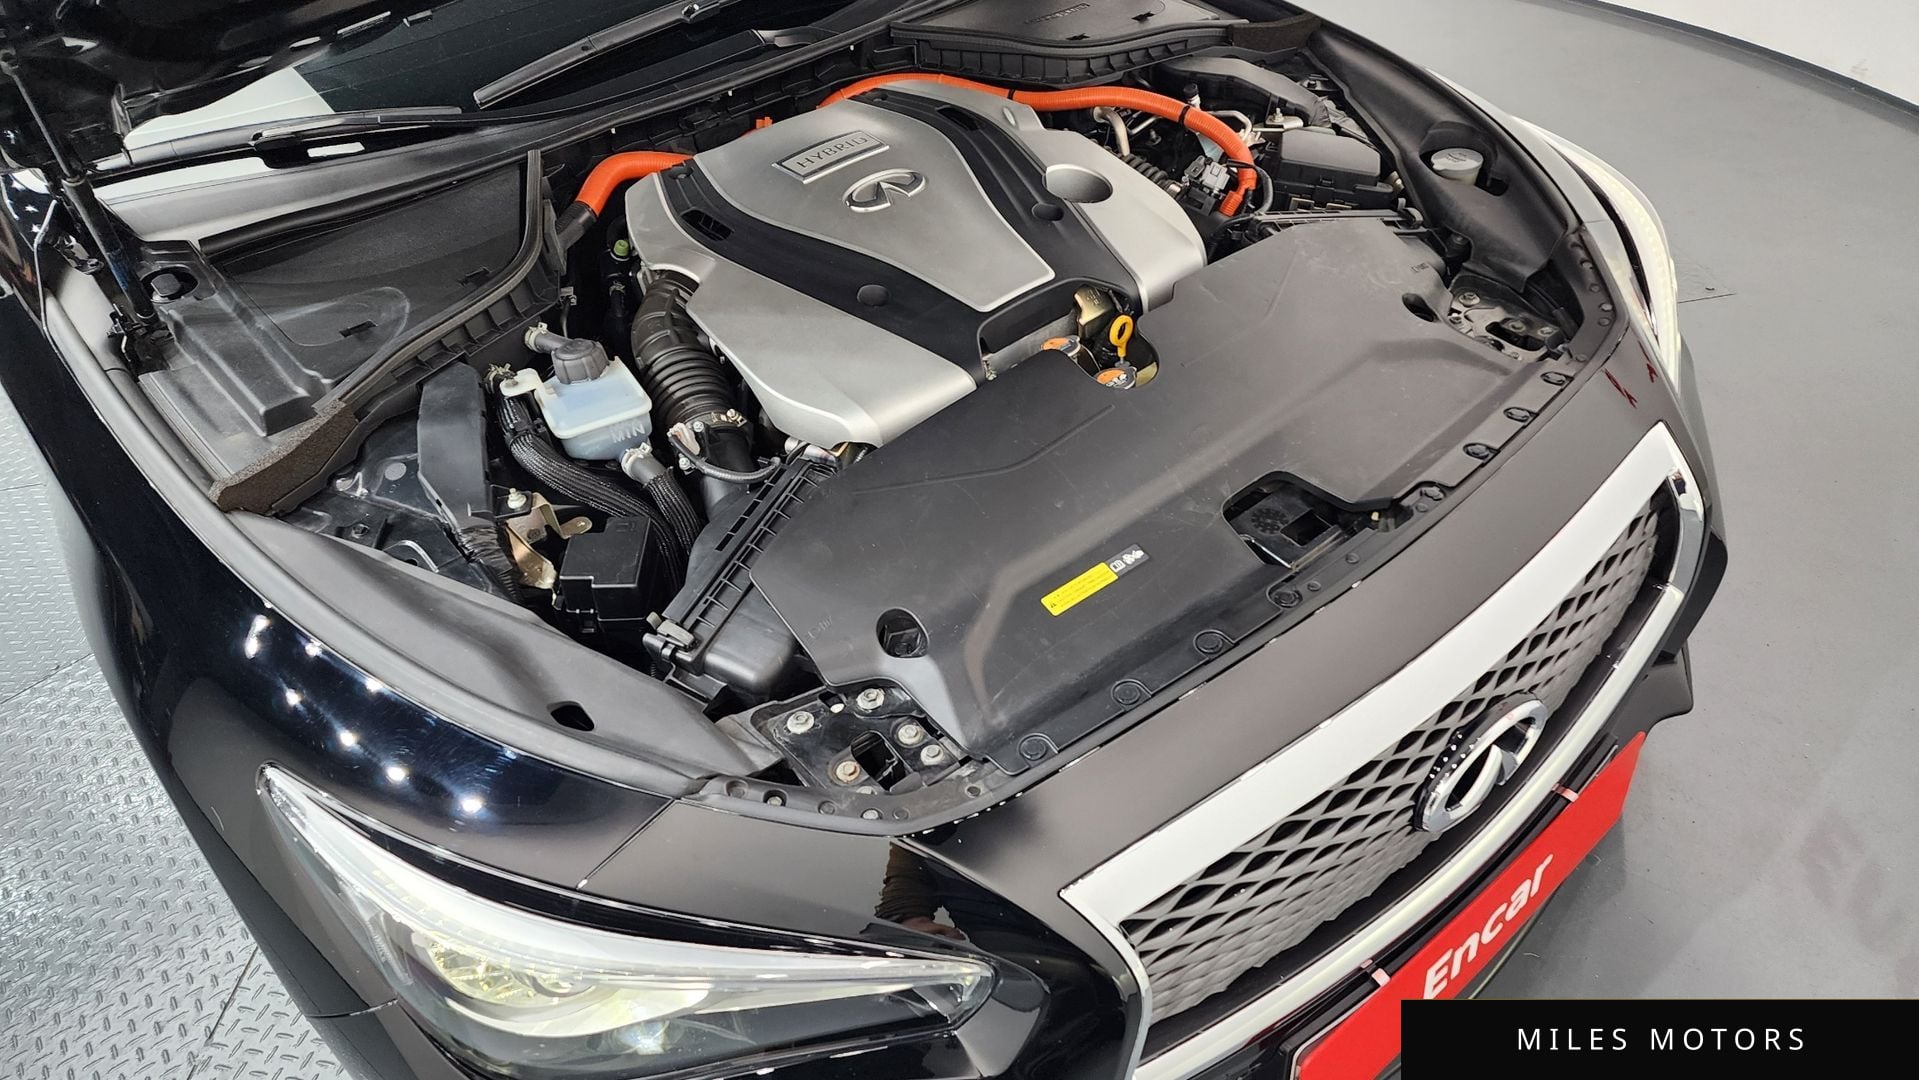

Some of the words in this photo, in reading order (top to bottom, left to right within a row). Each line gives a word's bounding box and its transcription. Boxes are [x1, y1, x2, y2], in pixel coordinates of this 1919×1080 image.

[796, 137, 868, 168] HYBRID
[611, 423, 646, 443] MIN
[1423, 853, 1554, 1000] Encar
